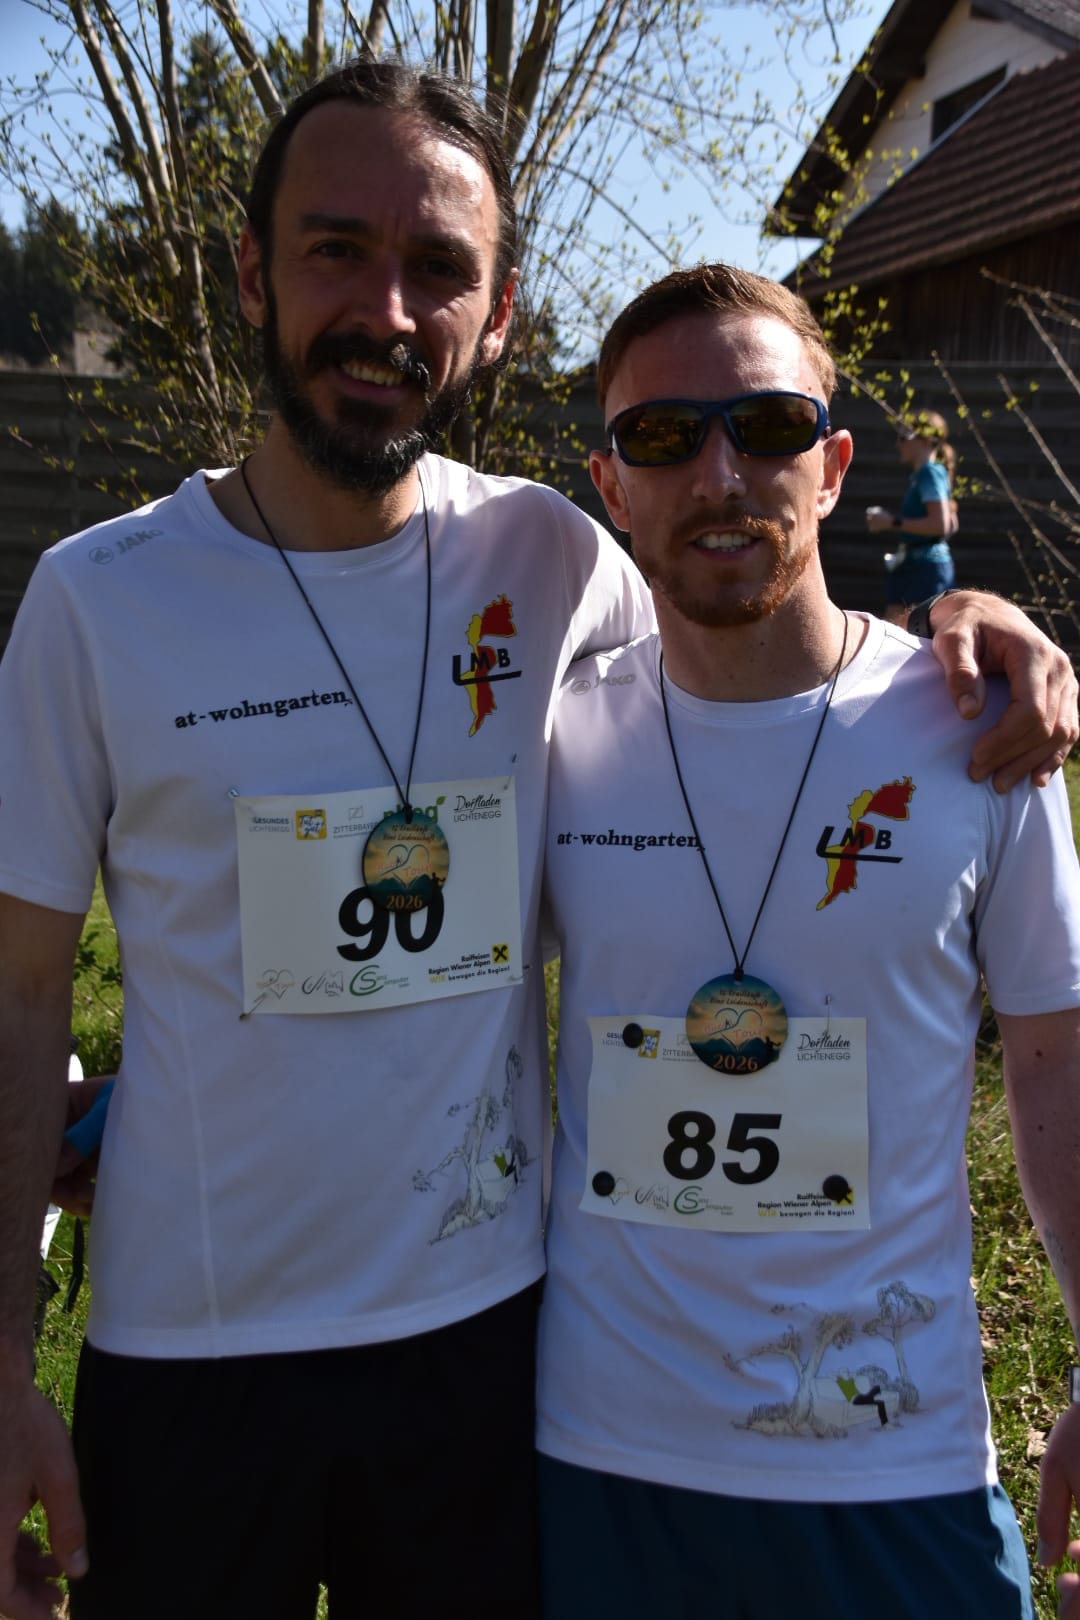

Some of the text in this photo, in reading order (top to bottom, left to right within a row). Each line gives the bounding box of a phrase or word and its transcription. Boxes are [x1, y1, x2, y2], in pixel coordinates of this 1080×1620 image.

[453, 648, 522, 686] LMB
[453, 794, 502, 813] Dorfladen
[453, 810, 502, 822] LICHTENEGG
[816, 826, 903, 863] LMB
[386, 894, 423, 909] 2026
[336, 886, 444, 962] 90
[797, 1030, 851, 1052] Dorfladen
[713, 1054, 759, 1071] 2026
[797, 1051, 851, 1061] LICHTENEGG
[663, 1110, 782, 1185] 85
